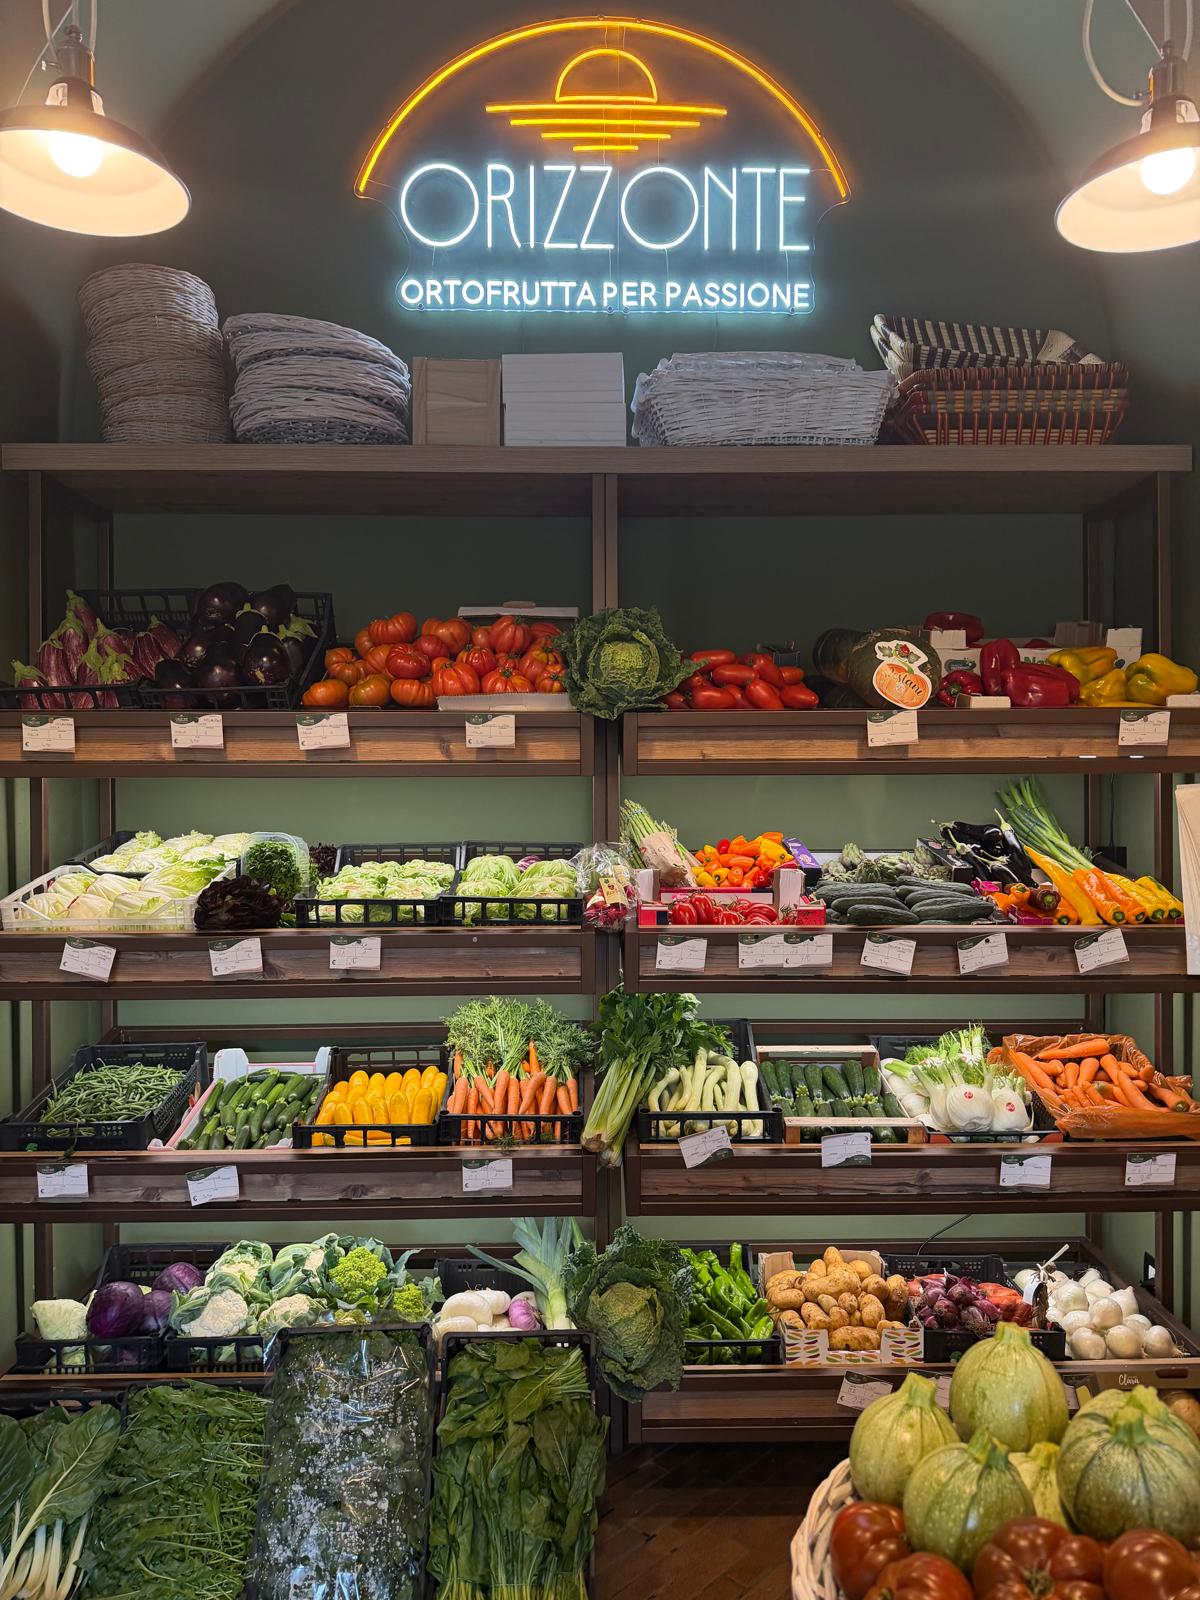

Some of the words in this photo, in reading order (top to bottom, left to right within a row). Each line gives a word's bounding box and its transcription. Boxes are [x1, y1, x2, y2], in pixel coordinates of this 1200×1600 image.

[400, 163, 811, 251] ORIZZONTE
[400, 279, 596, 307] ORTOFRUTTA
[602, 281, 657, 308] PER
[664, 281, 811, 309] PASSIONE
